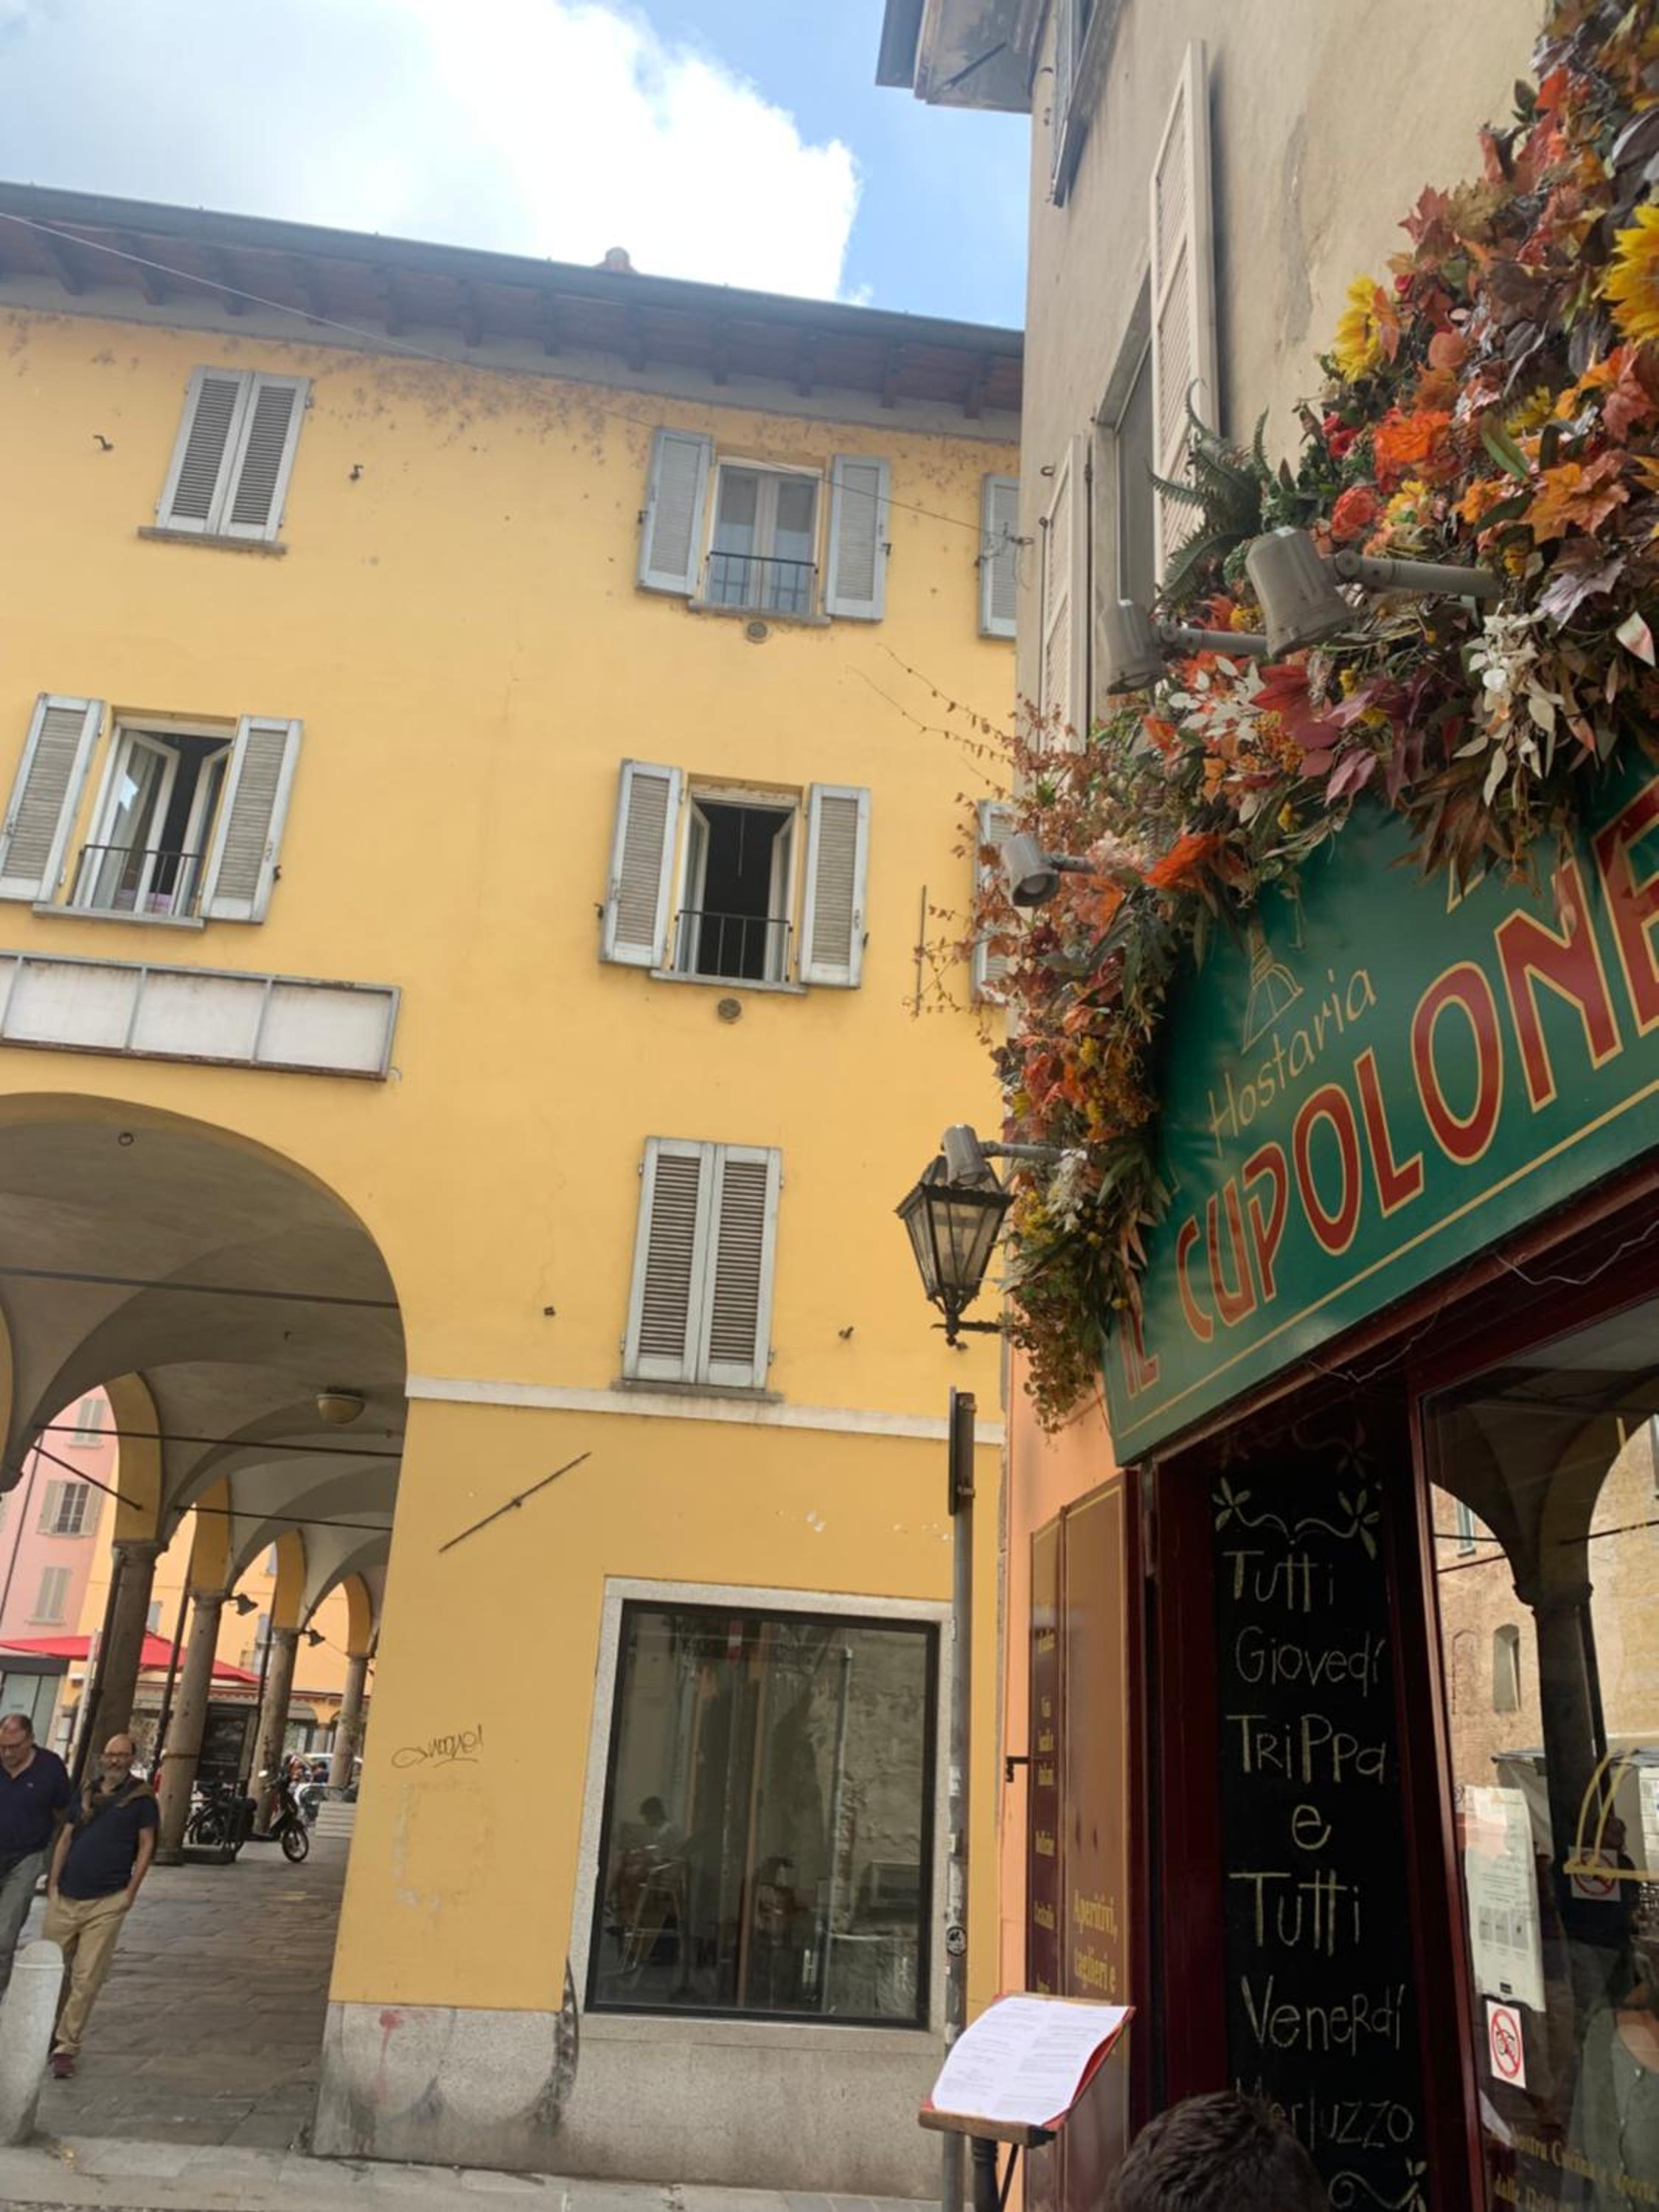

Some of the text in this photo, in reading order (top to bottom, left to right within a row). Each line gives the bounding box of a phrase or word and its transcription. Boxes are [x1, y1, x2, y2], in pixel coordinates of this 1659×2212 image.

[1175, 774, 1659, 1343] CUPOLONE
[1208, 967, 1377, 1159] Hostaria
[1222, 1550, 1335, 1613] Tutti
[1291, 1804, 1332, 1850] e
[1228, 1868, 1360, 1957] Tutti
